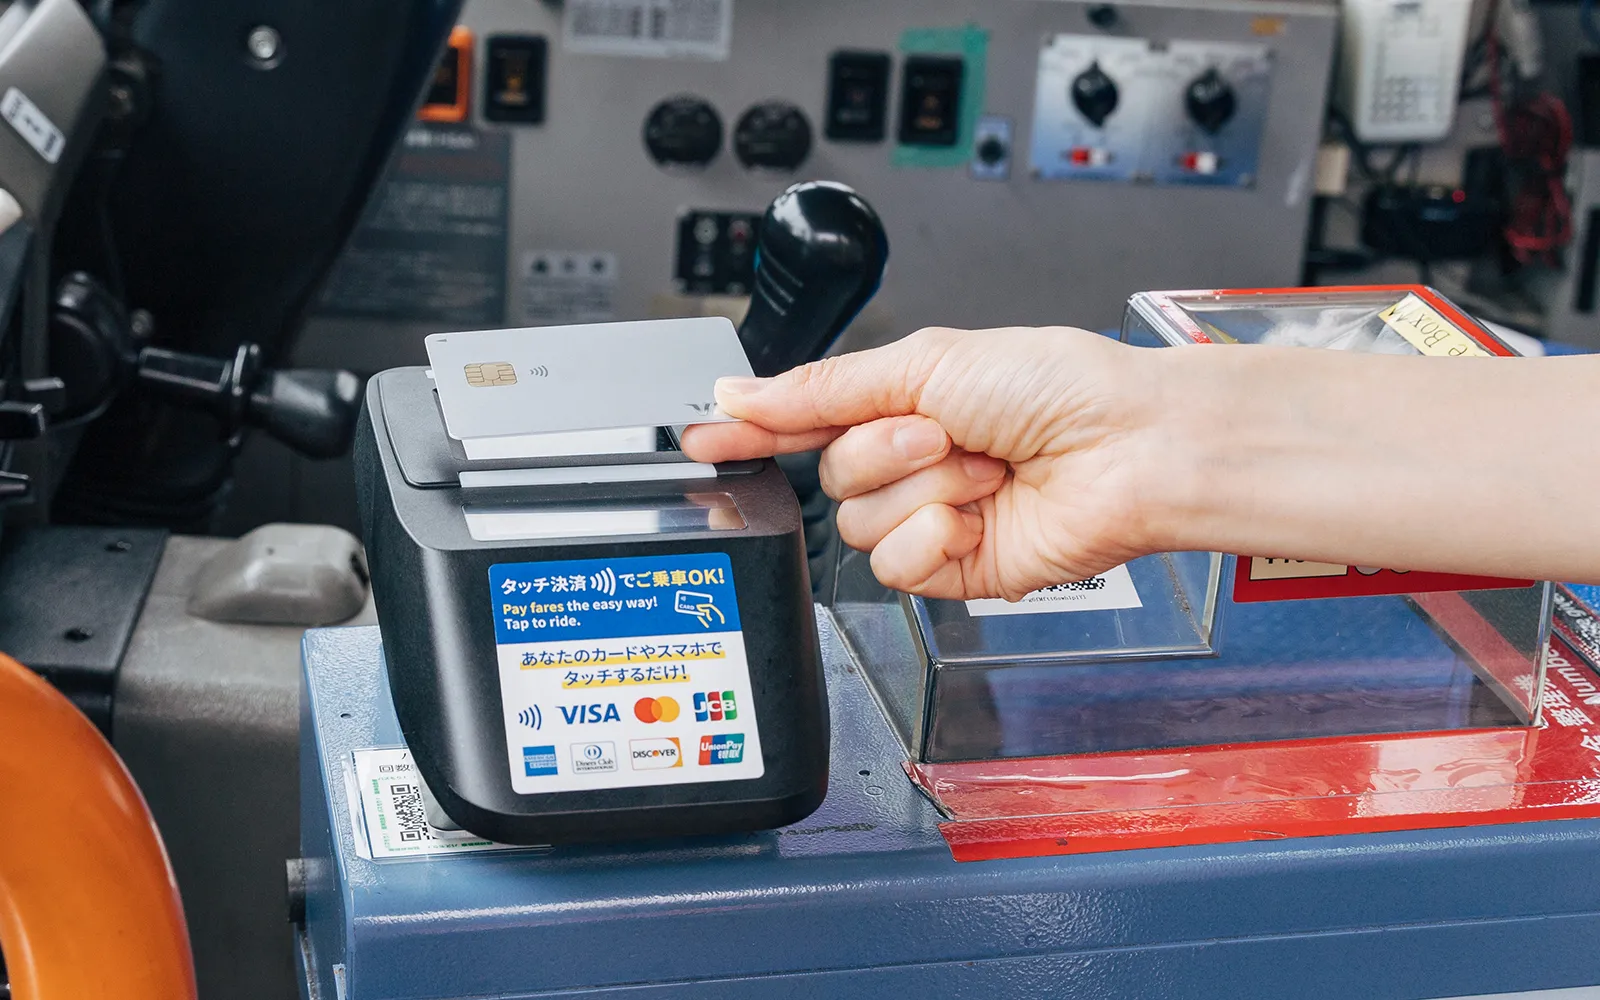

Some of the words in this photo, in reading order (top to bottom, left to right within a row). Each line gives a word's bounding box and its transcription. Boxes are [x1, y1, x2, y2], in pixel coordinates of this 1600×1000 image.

[501, 574, 587, 595] タッチ決済
[618, 568, 725, 588] でご乗車OK!
[502, 604, 527, 617] Pay
[530, 601, 564, 614] fares
[566, 599, 590, 612] the
[592, 600, 623, 612] easy
[626, 596, 658, 610] way!
[503, 618, 530, 632] Tap
[532, 617, 547, 629] to
[549, 615, 581, 628] ride.
[521, 641, 723, 667] あなたのカードやスマホで
[564, 664, 689, 687] タッチするだけ!
[1548, 648, 1600, 705] Numbe
[556, 703, 621, 725] VISA
[694, 696, 737, 718] JCB
[632, 749, 676, 759] DISCOVER
[700, 741, 743, 752] UnionPay
[379, 764, 415, 773] 回数
